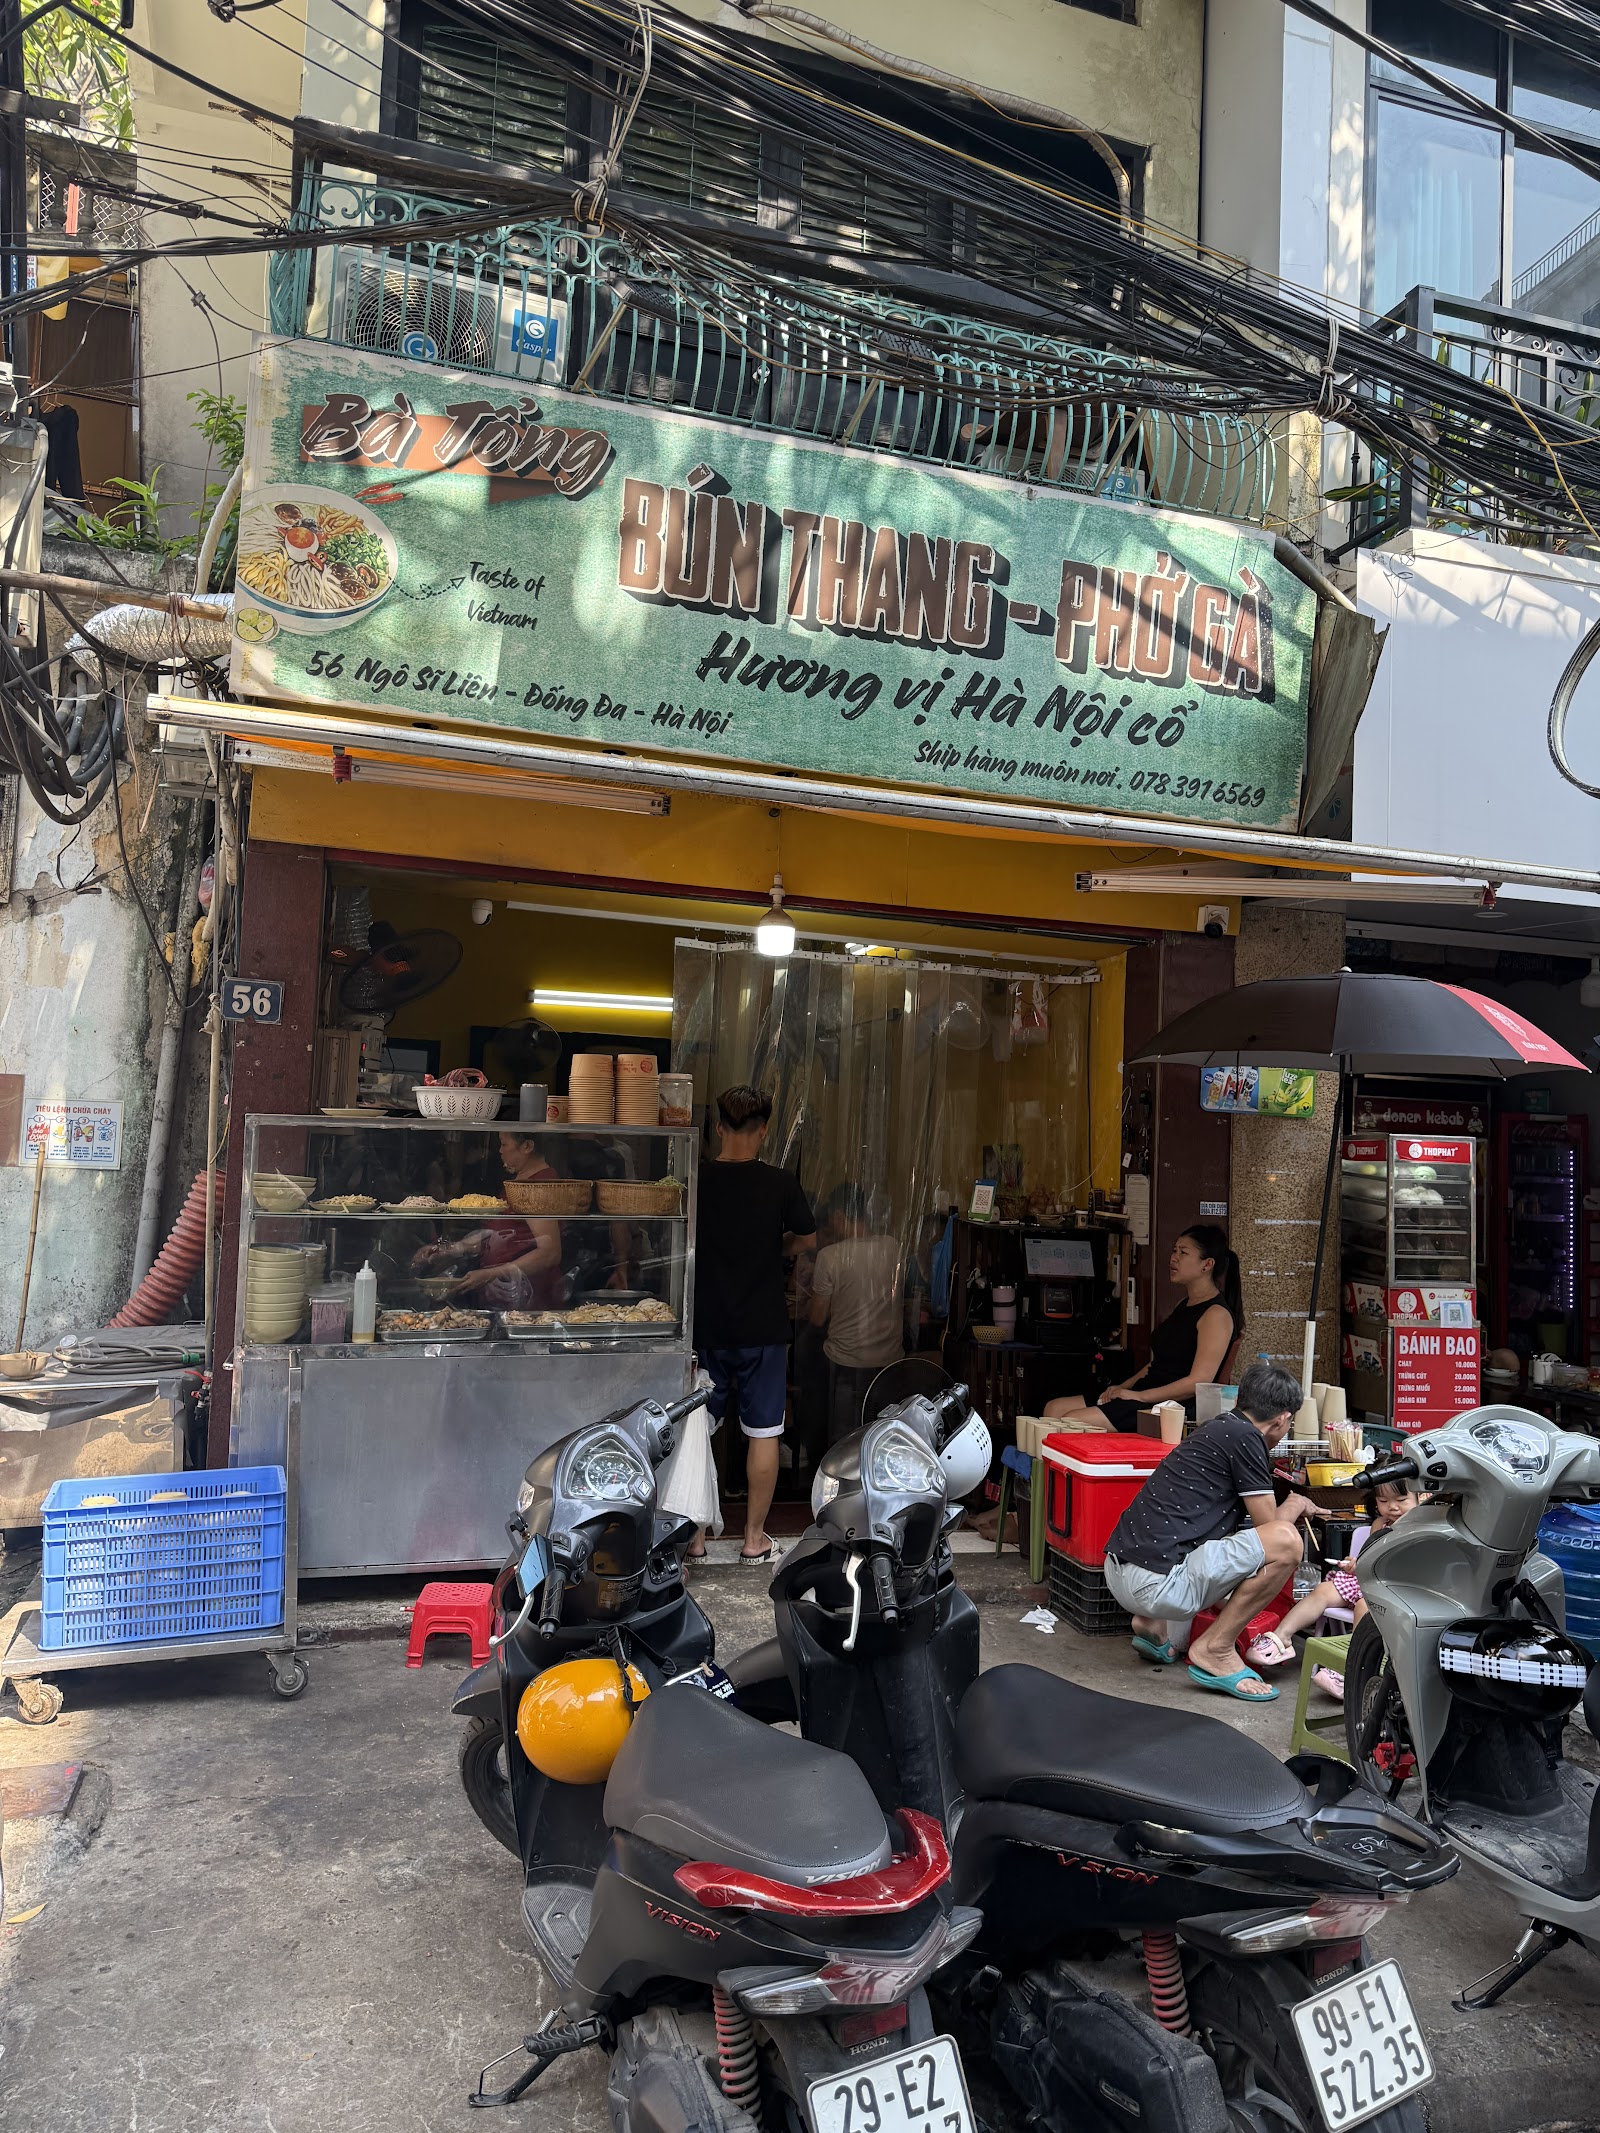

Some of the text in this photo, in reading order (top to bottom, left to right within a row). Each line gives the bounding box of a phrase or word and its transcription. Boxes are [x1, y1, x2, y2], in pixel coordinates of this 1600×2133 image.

[516, 339, 553, 356] Caspr
[301, 393, 614, 500] Bà Tổng
[468, 561, 547, 601] Taste of
[618, 463, 770, 616] BÚN
[781, 509, 998, 650] THANG
[1054, 552, 1188, 679] PHỞ
[1189, 565, 1266, 695] GÀ
[467, 600, 539, 631] Vietnam
[305, 650, 346, 680] 56
[354, 656, 409, 693] Ngô
[413, 664, 443, 692] Sĩ
[445, 670, 499, 701] Liên
[523, 682, 590, 722] Đống
[594, 693, 628, 722] Đa
[650, 702, 686, 730] Hà
[687, 706, 734, 739] Nội
[695, 631, 1199, 748] Hương vị Hà Nội cổ
[914, 740, 961, 771] Ship
[963, 745, 1018, 782] hàng
[1020, 760, 1081, 783] muôn
[231, 984, 273, 1016] 56
[35, 1104, 112, 1115] TIÊU LỆNH CHỮA CHÁY
[1383, 1107, 1465, 1126] doner kebab
[1399, 1331, 1477, 1356] BÁNH BAO
[804, 1857, 882, 1885] VISION
[1056, 1852, 1159, 1885] VSON
[644, 1900, 721, 1942] VISION
[1314, 1965, 1350, 1987] HONDA
[1311, 1974, 1397, 2057] 99-E1
[850, 2036, 890, 2056] HOND
[1320, 2023, 1425, 2120] 522.35
[833, 2053, 946, 2133] 29-E2
